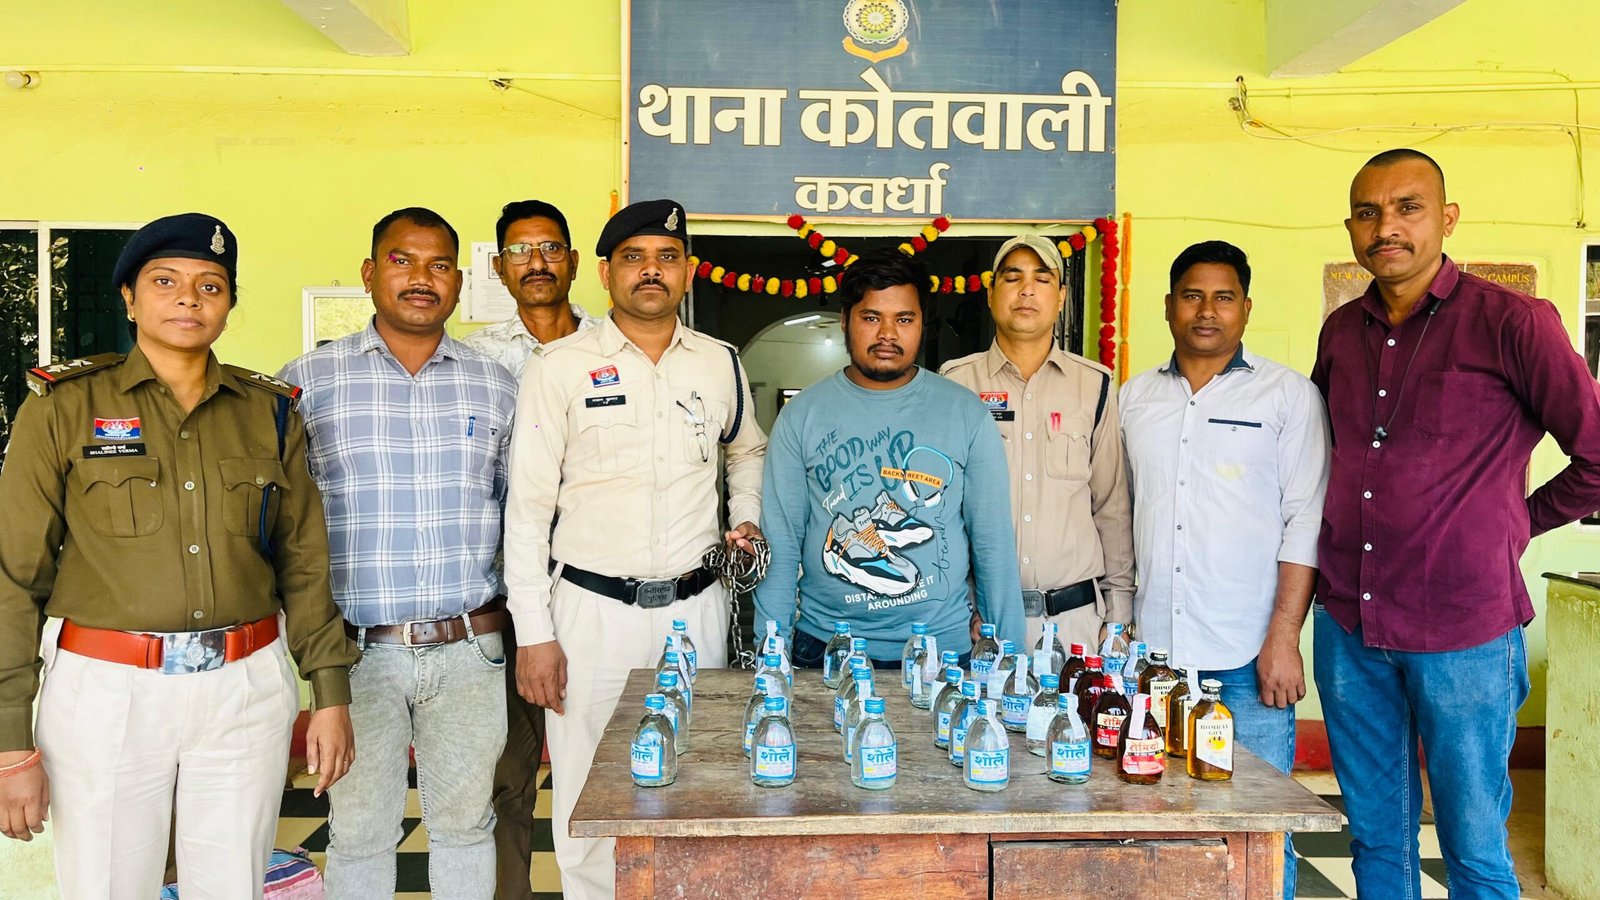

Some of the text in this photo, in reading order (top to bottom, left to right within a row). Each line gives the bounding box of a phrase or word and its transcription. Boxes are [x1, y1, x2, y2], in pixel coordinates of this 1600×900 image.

[637, 66, 1113, 152] थाना कोतवाली
[793, 162, 951, 215] कवर्धा
[1331, 271, 1353, 280] NEW
[1487, 273, 1530, 283] CAMPUS
[815, 428, 839, 457] THE
[814, 426, 891, 493] GOOD WAY
[842, 429, 915, 501] IS UP
[882, 469, 941, 486] BACKSTREET AREA
[926, 575, 934, 585] IT
[867, 589, 928, 611] AROUNDING
[760, 748, 790, 762] शोले
[866, 748, 895, 763] शोले
[974, 752, 1005, 766] शोले
[1056, 745, 1087, 759] शोले
